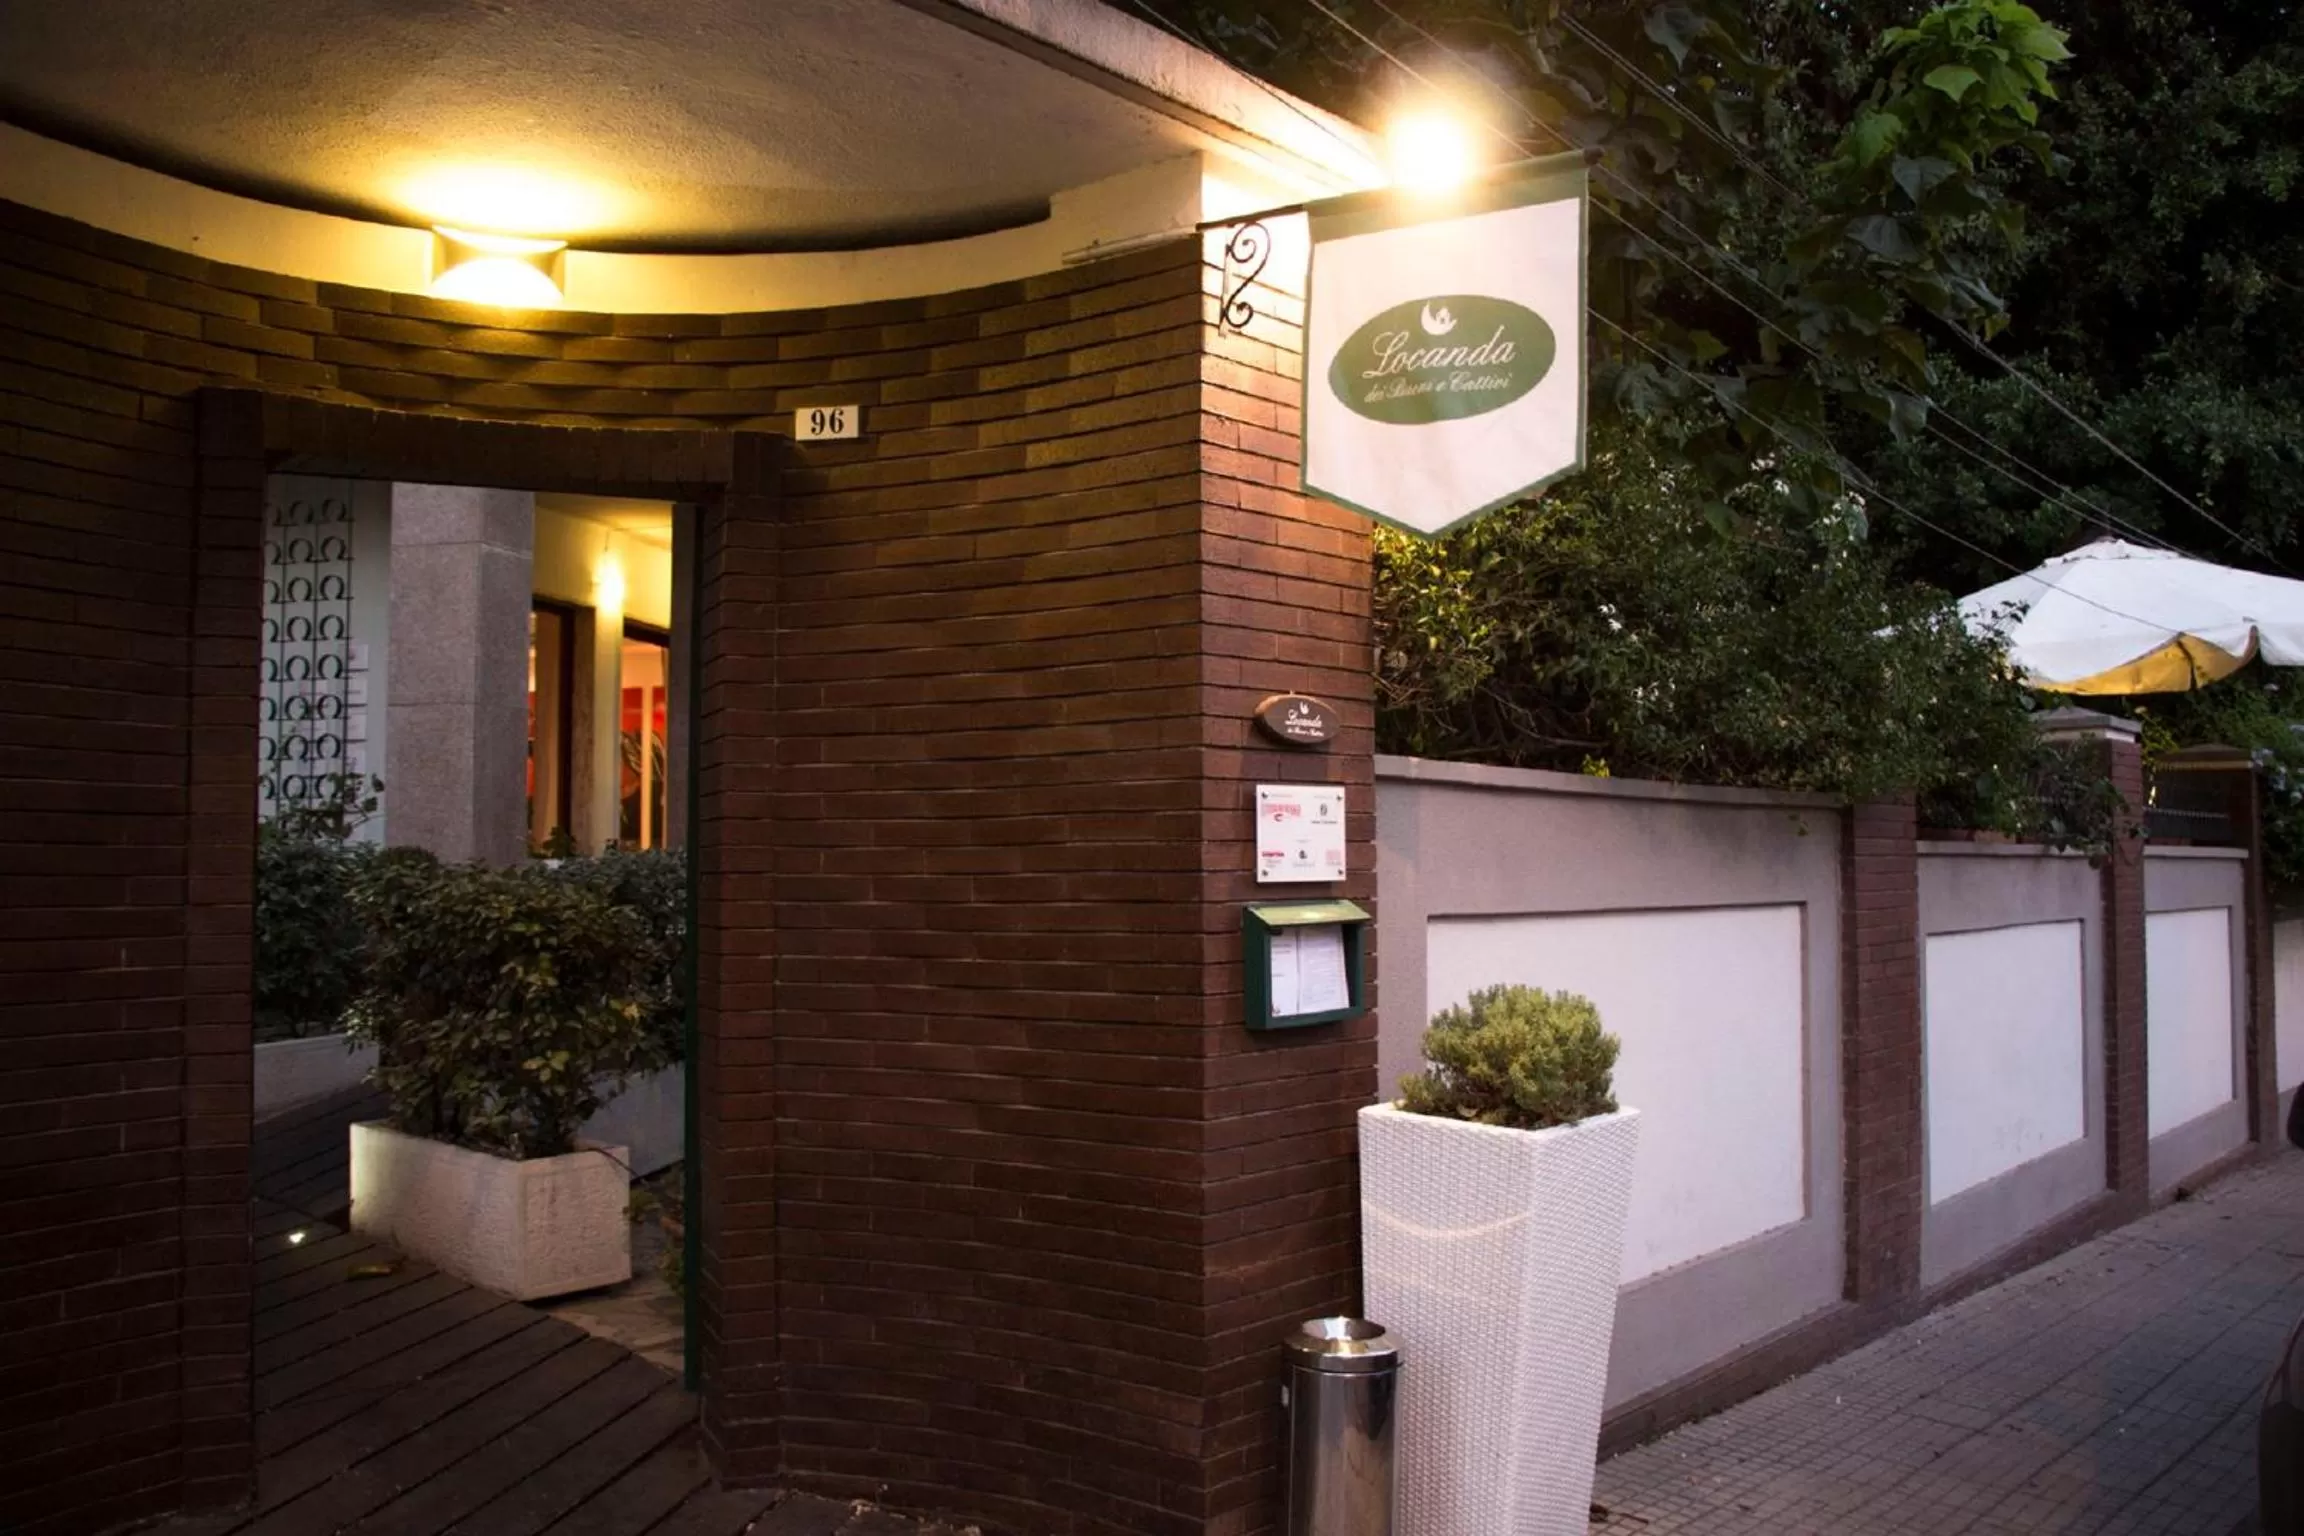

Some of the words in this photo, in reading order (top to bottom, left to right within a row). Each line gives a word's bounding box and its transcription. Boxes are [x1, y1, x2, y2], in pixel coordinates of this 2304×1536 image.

[1361, 325, 1516, 380] Locanda
[1435, 380, 1446, 393] e
[811, 408, 844, 436] 96
